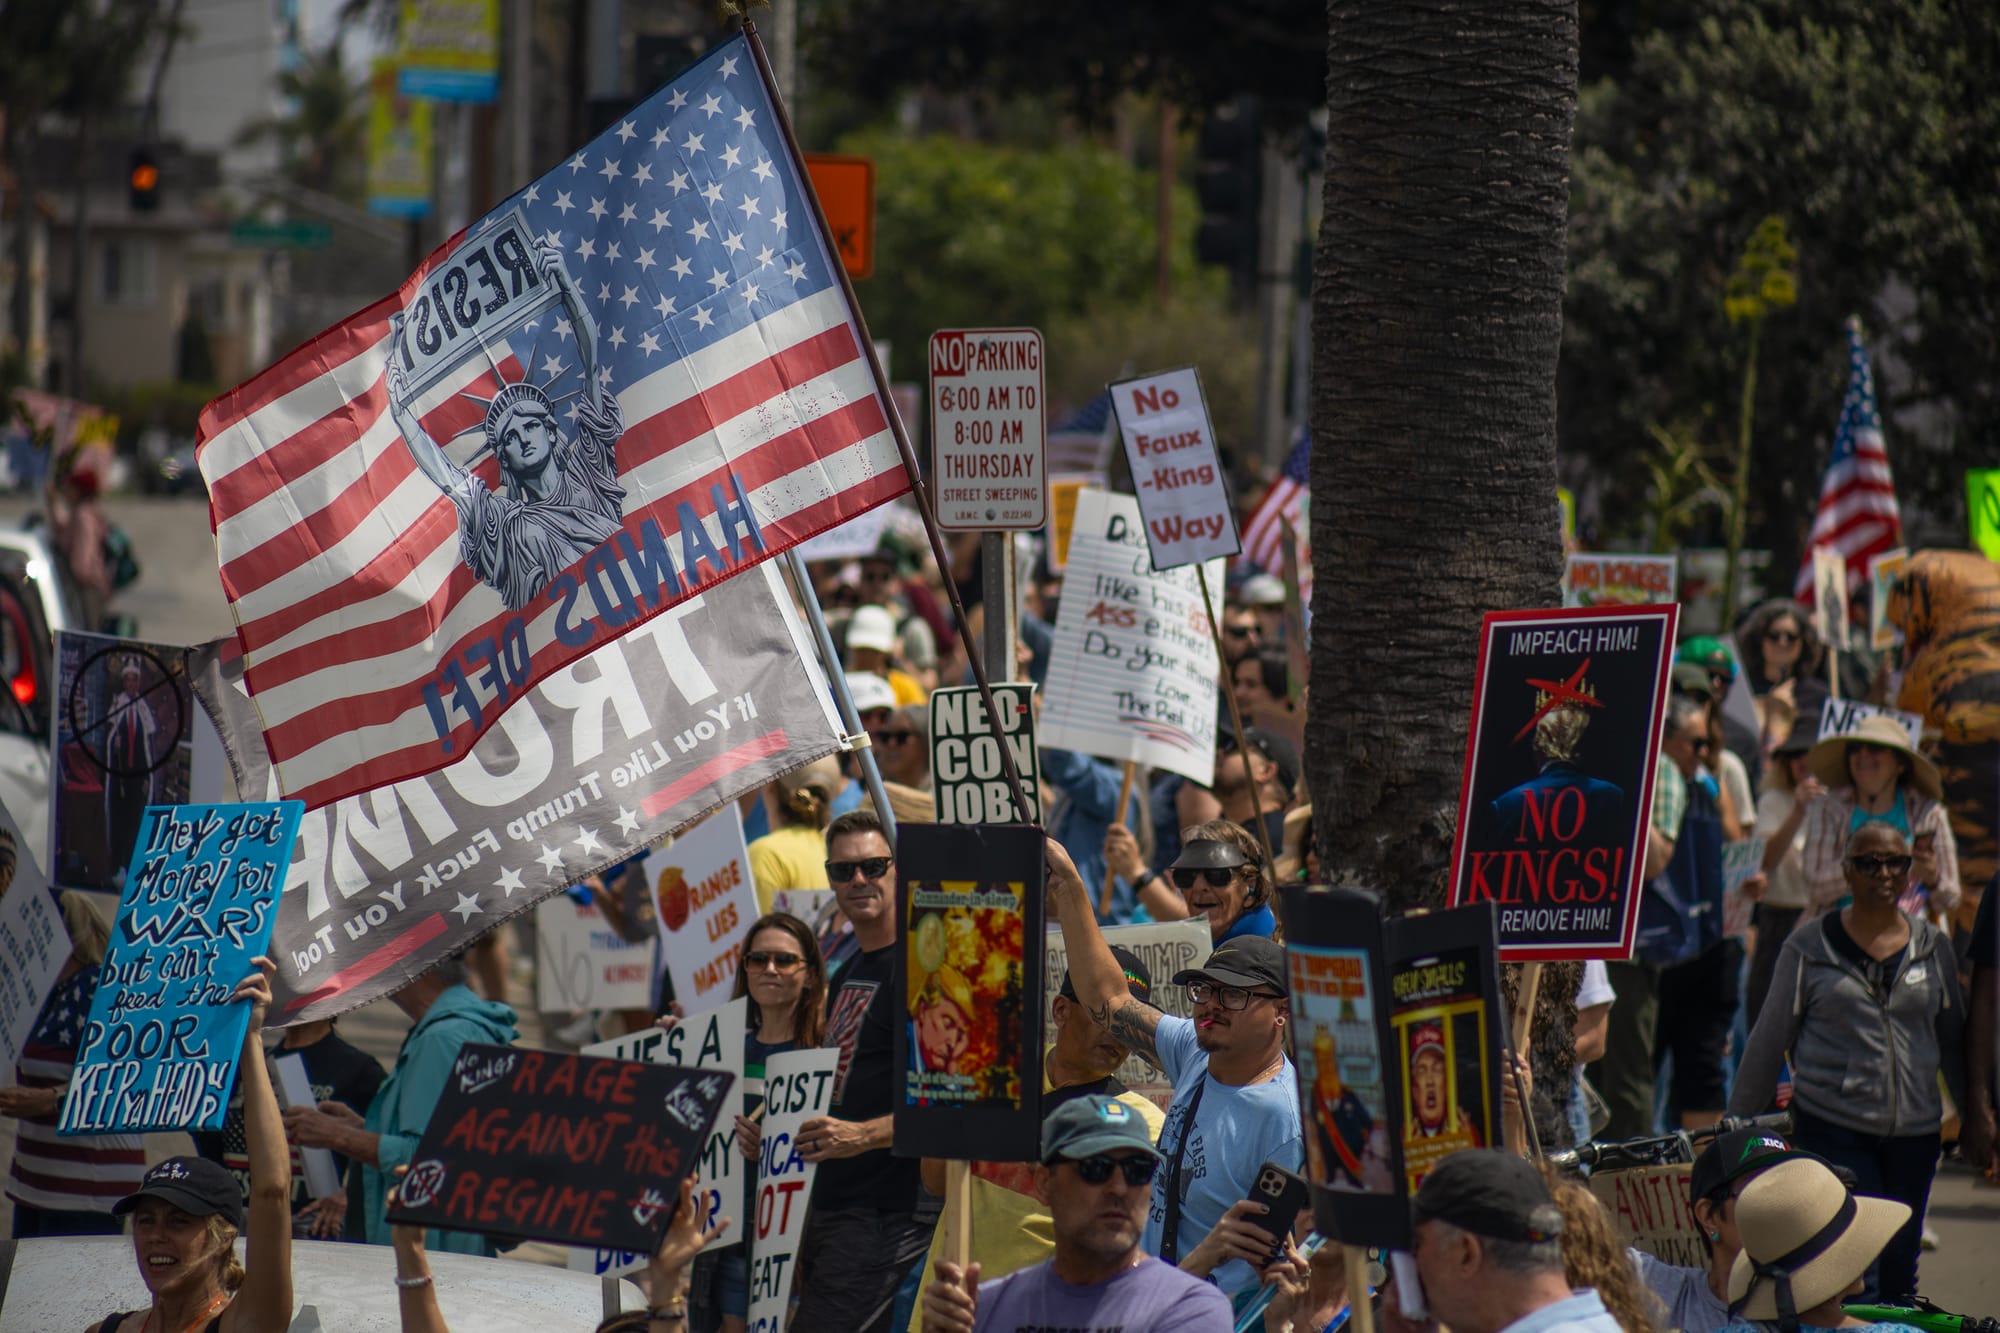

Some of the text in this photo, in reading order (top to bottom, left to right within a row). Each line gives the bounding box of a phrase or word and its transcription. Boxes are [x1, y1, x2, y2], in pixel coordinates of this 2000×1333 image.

[933, 337, 1038, 372] NO PARKING
[940, 385, 1036, 412] 6:00 AM TO
[1132, 385, 1180, 416] No
[954, 420, 1023, 445] 8:00 AM
[1136, 430, 1202, 458] Faux
[944, 453, 1035, 479] THURSDAY
[1142, 463, 1215, 491] -King
[943, 488, 1038, 502] STREET SWEEPING
[1151, 513, 1225, 546] Way
[1096, 575, 1140, 602] like
[1086, 602, 1137, 628] ASS
[1084, 631, 1122, 659] Do
[1126, 644, 1178, 671] your
[1509, 626, 1640, 657] IMPEACH HIM!
[936, 736, 1033, 781] CON
[940, 779, 1037, 825] JOBS
[1515, 787, 1587, 843] NO
[145, 806, 283, 861] They got
[123, 854, 276, 916] Money for
[1465, 847, 1624, 906] KINGS!
[119, 897, 274, 950] WARS
[706, 902, 740, 944] LIES
[1500, 907, 1611, 932] REMOVE HIM!
[101, 942, 220, 988] but can't
[108, 977, 236, 1025] feed the
[78, 1015, 209, 1065] POOR
[59, 1060, 141, 1131] KEEP
[122, 1089, 149, 1128] YA
[143, 1060, 208, 1129] HEAD
[512, 1053, 646, 1105] RAGE
[444, 1107, 681, 1178] AGAINST this
[446, 1170, 616, 1239] REGIME
